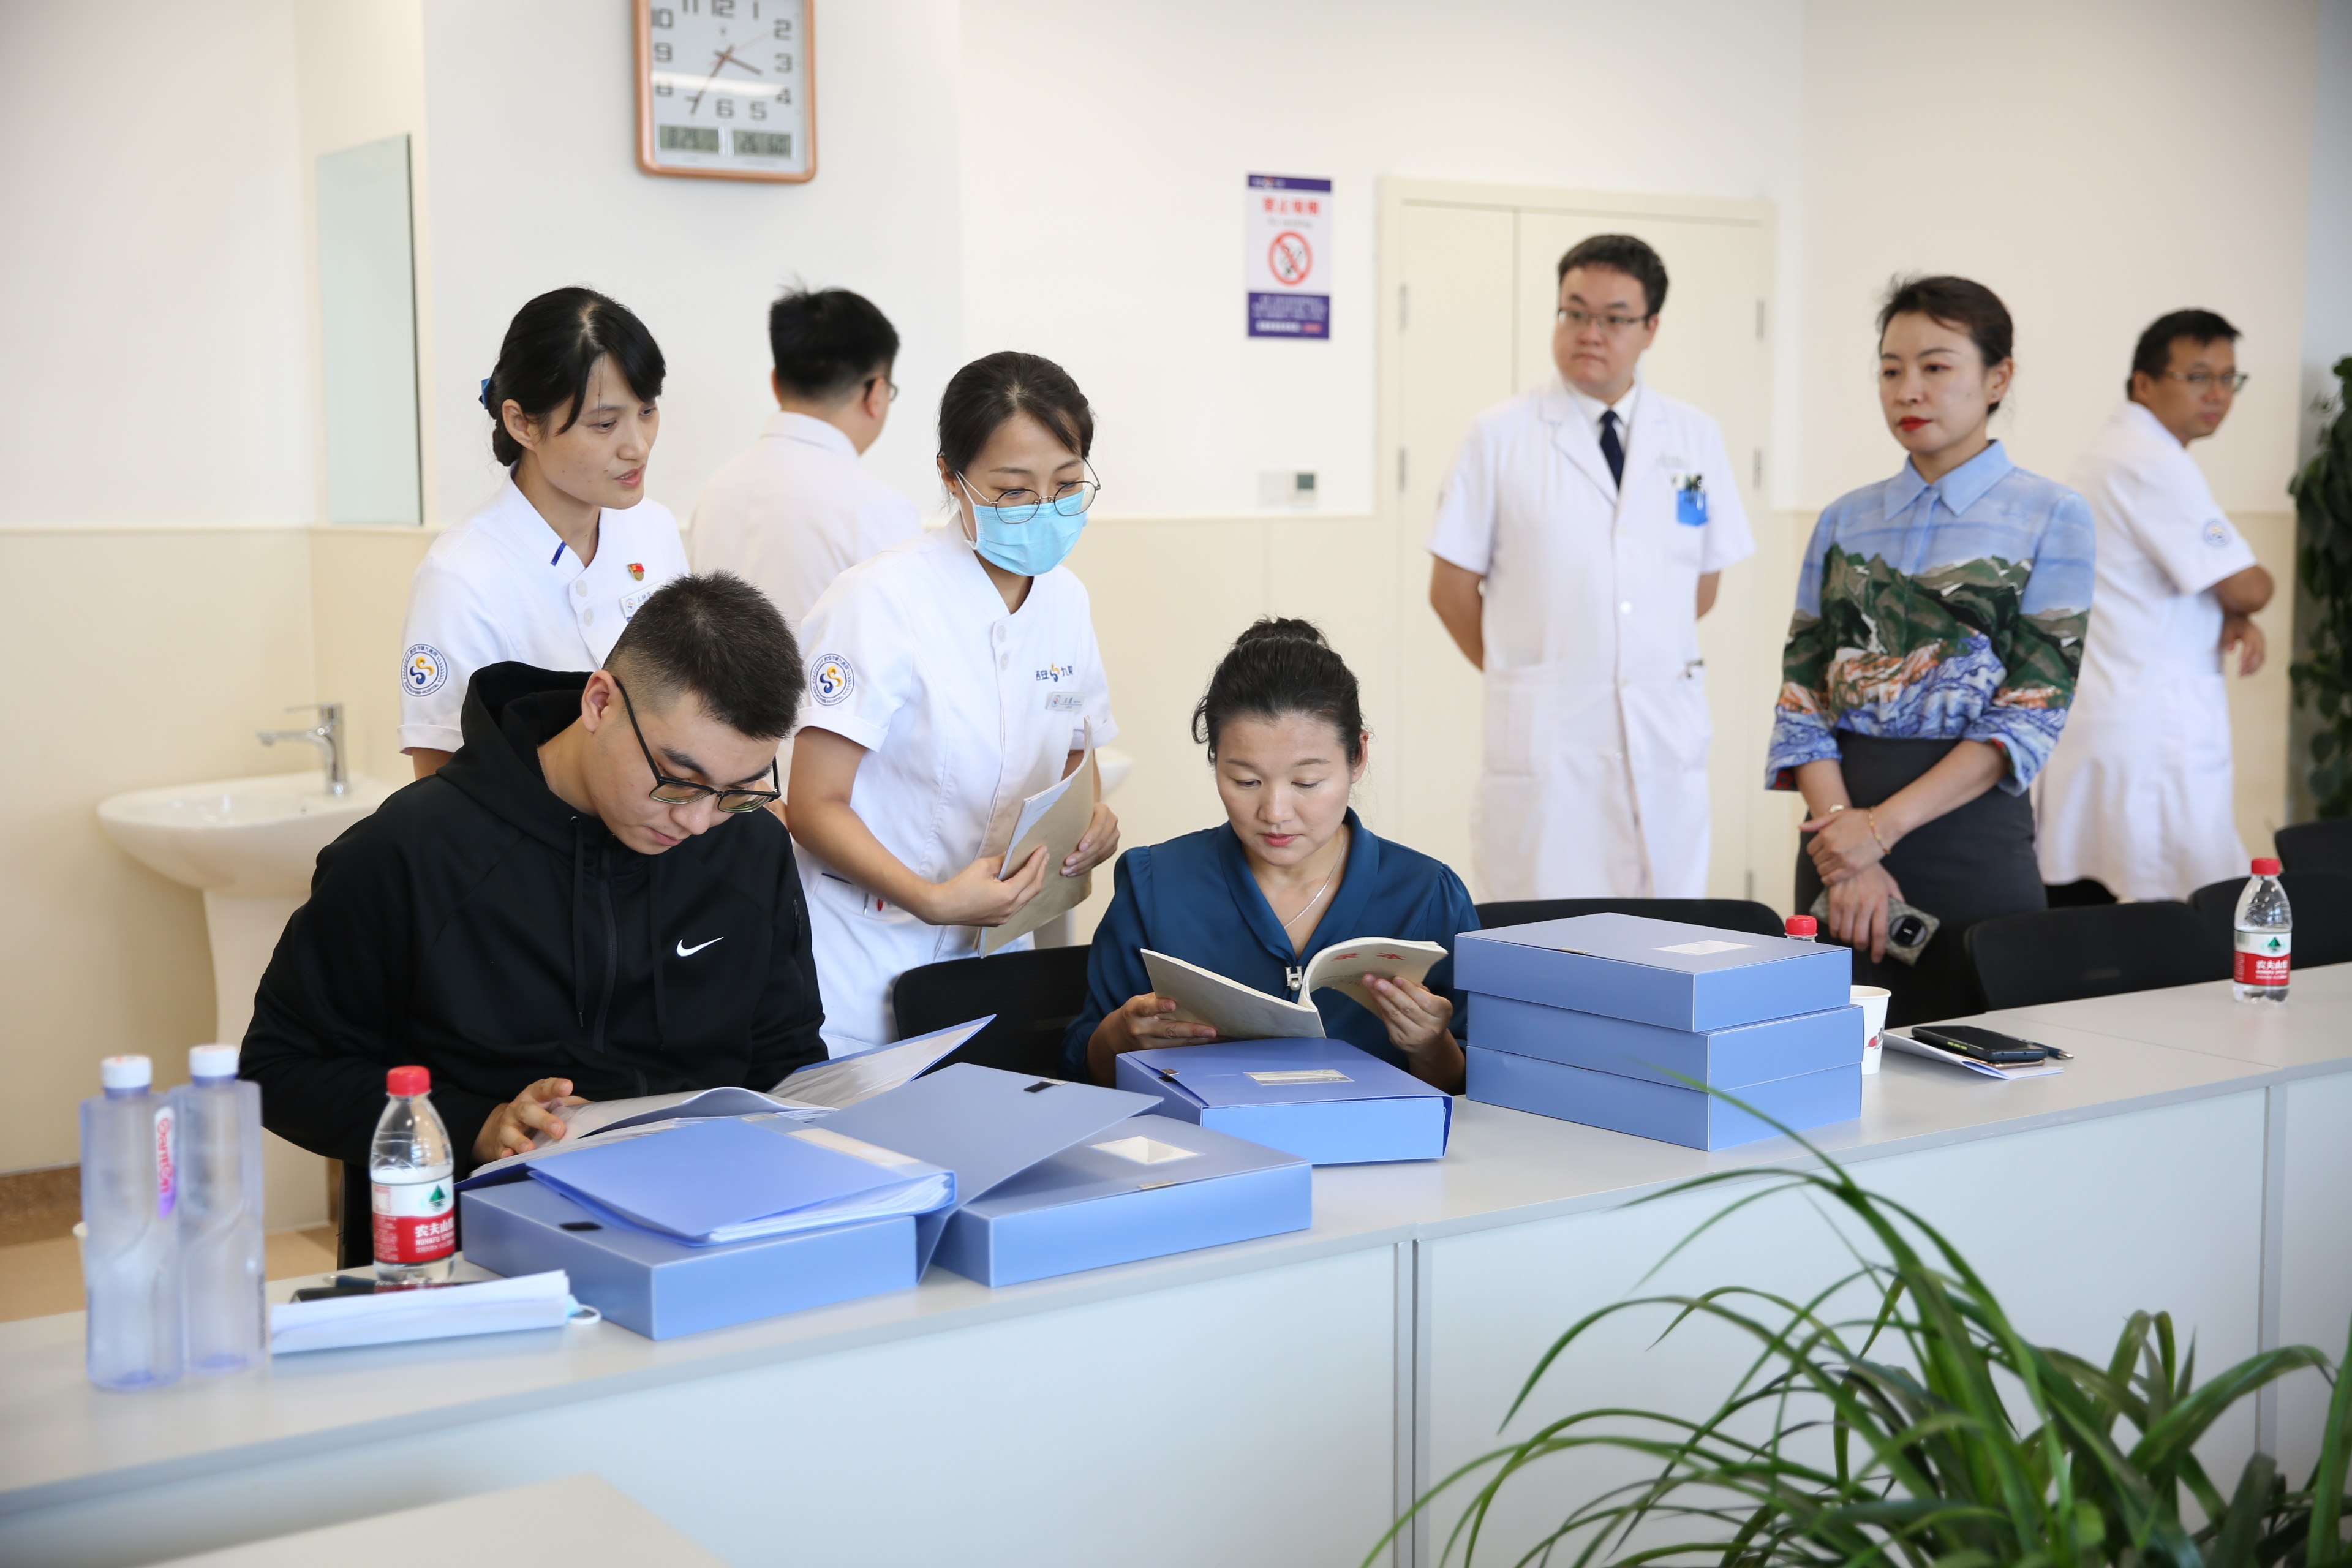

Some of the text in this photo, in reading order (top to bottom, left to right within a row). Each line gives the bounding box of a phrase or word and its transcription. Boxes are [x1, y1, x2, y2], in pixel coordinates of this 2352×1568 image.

[774, 18, 792, 40] 2
[654, 42, 673, 62] 9
[774, 53, 793, 73] 3
[716, 98, 734, 119] 6
[749, 100, 767, 121] 5
[416, 1236, 440, 1246] NONGFU
